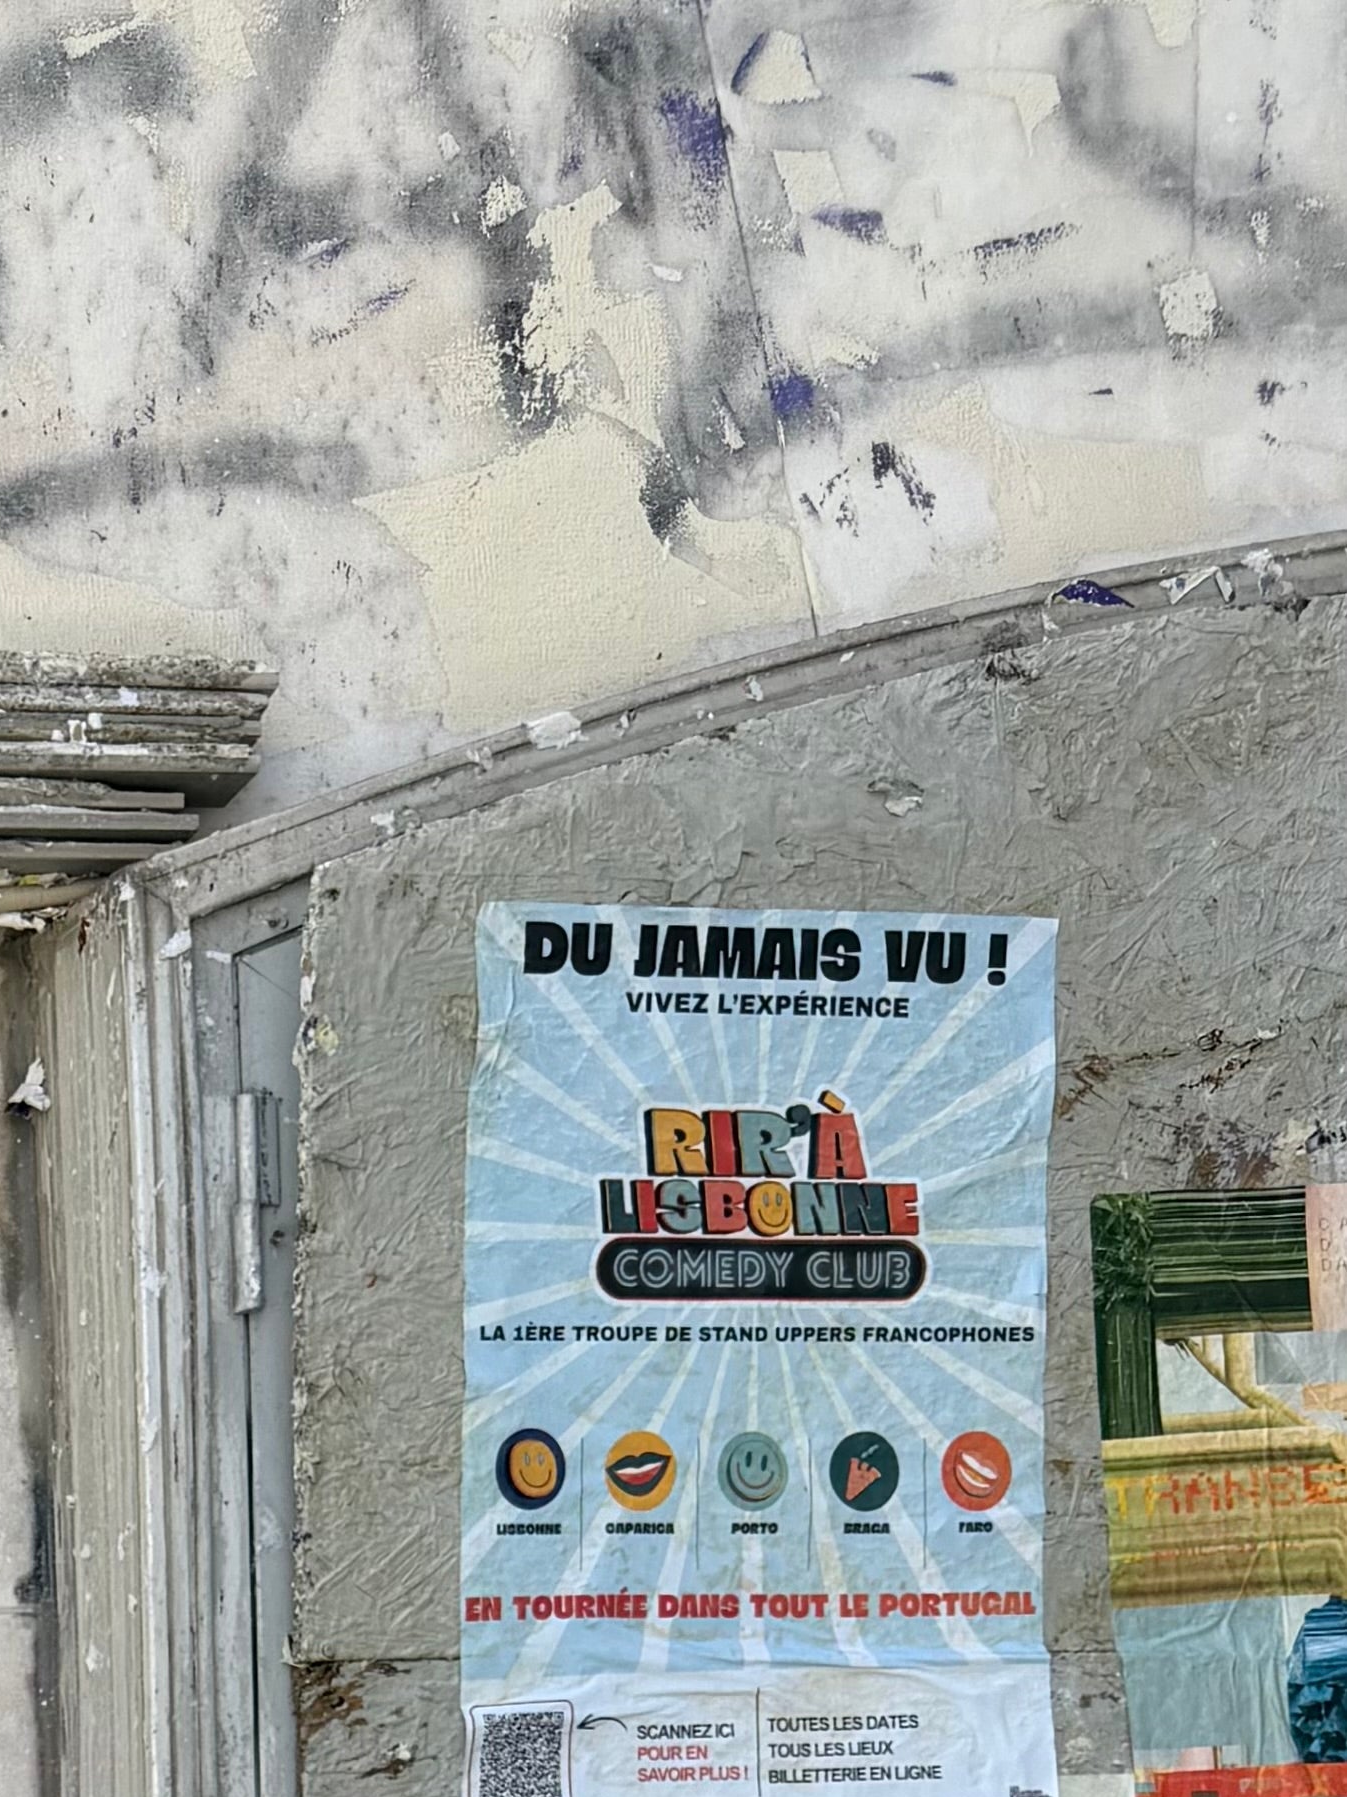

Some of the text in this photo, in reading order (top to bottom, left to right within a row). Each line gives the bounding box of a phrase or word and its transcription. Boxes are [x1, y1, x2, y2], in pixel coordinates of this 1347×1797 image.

[523, 921, 967, 985] DU JAMAIS VU
[625, 990, 910, 1019] VIVEZ L'EXPÉRIENCE
[599, 1179, 920, 1237] LISBONNE
[612, 1248, 912, 1289] COMEDY CLUB
[479, 1320, 1035, 1343] LA 1ÈRE TROUPE DE STAND UPPERS FRANCOPHONES
[731, 1522, 779, 1535] PORTO
[465, 1587, 1037, 1622] EN TOURNÉE DANS TOUT LE PORTUGAL
